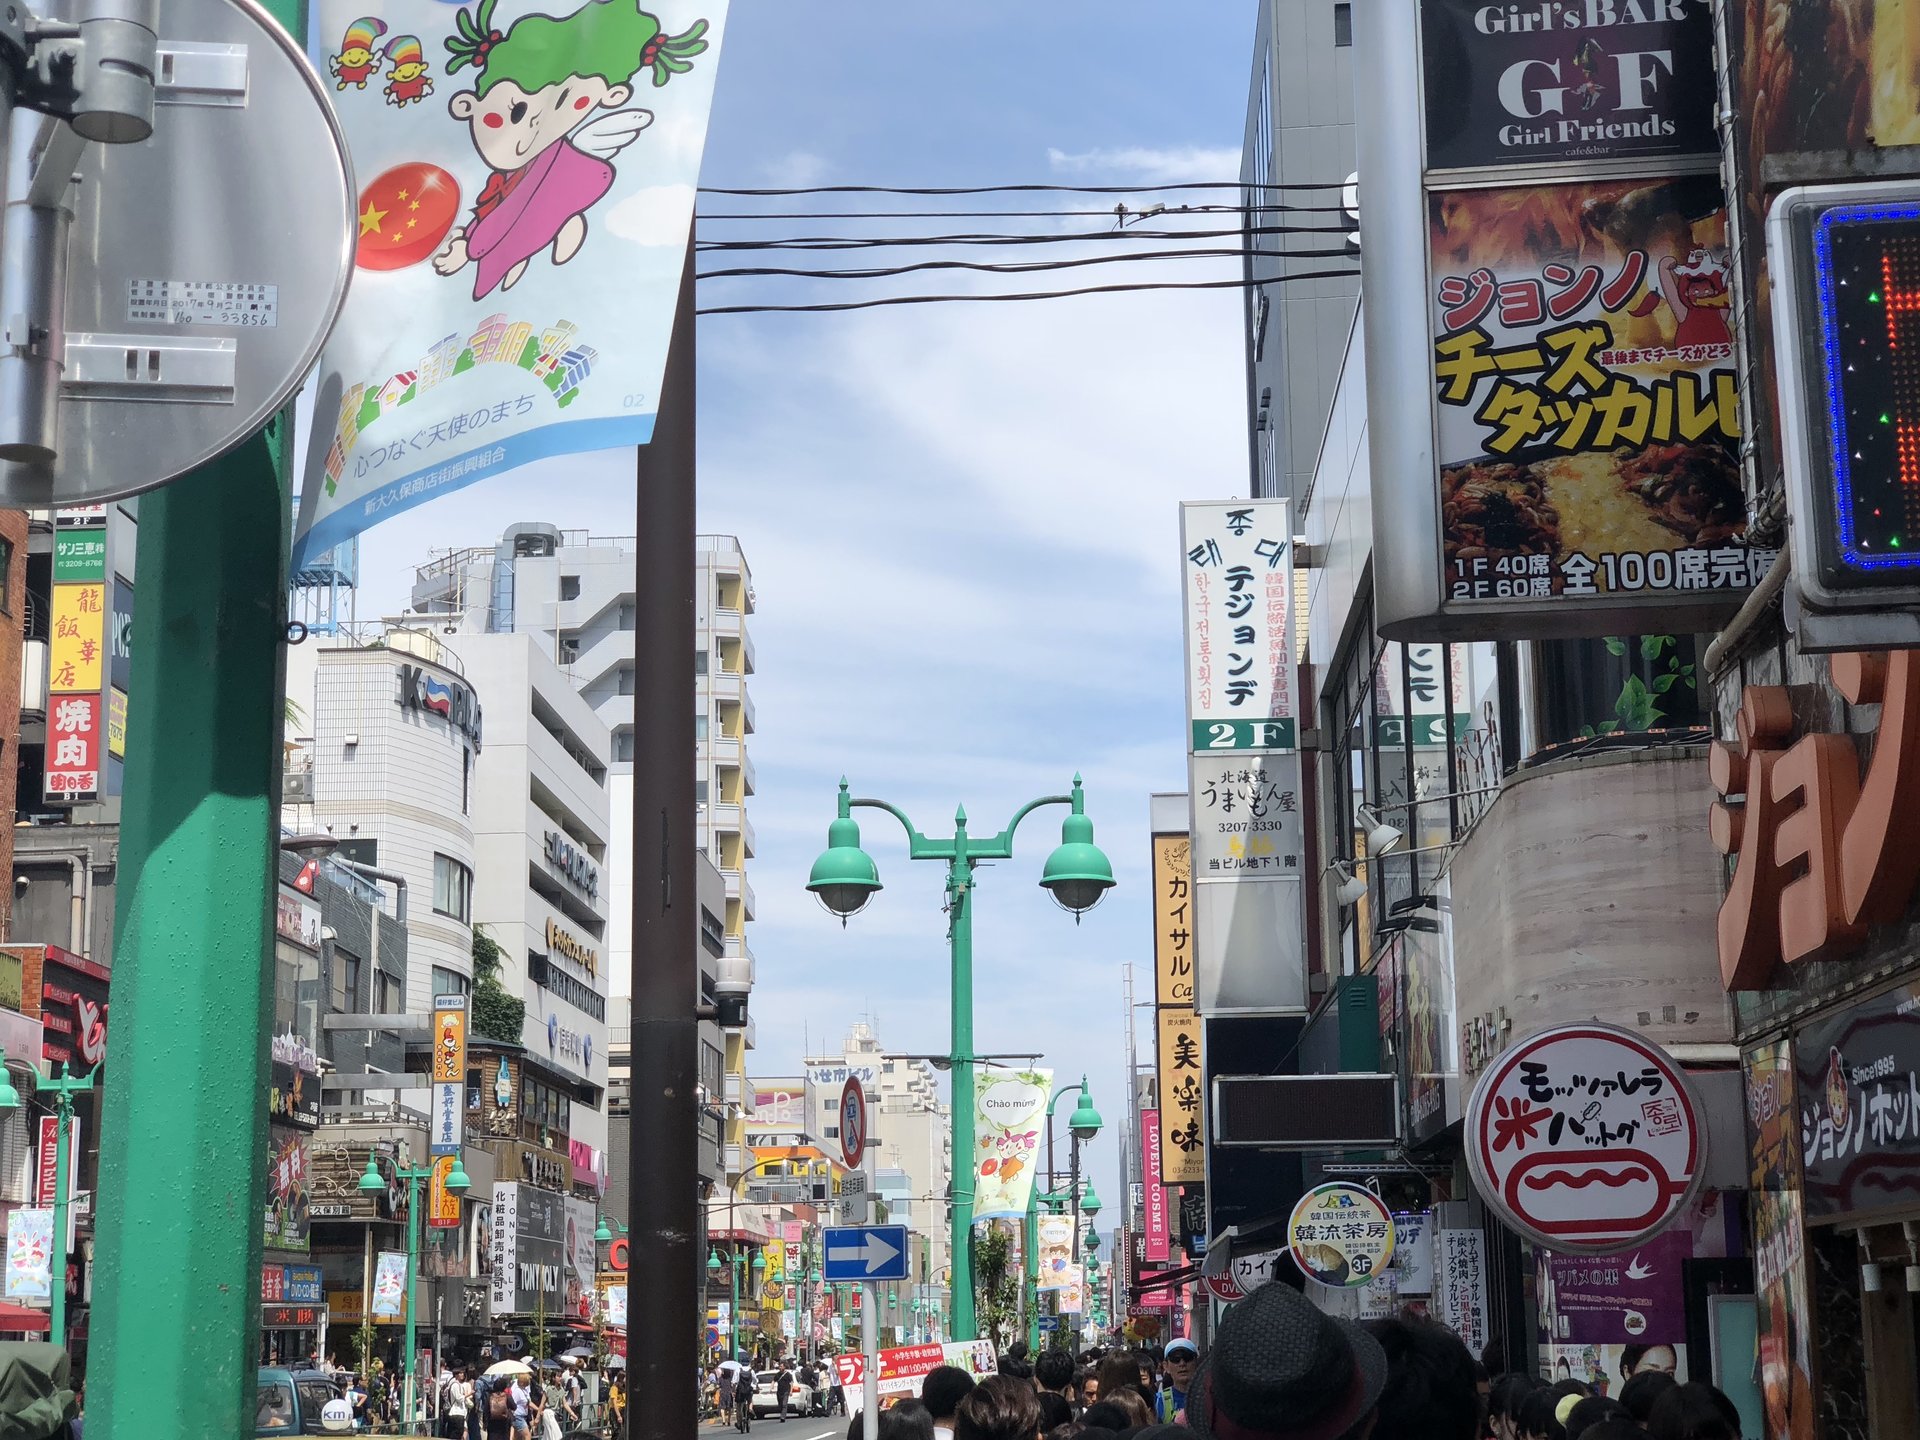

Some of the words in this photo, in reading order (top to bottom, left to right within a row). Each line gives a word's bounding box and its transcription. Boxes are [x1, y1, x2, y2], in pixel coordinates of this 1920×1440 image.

[1499, 125, 1551, 146] Girl
[1559, 114, 1676, 144] Friends
[1565, 146, 1611, 157] cafe&bar
[184, 282, 265, 292] 東京都公安委員会
[1440, 250, 1649, 330] ジョンノ
[130, 299, 168, 307] 設置年月日
[131, 311, 166, 319] 規制番号
[221, 312, 268, 325] 33856
[1435, 325, 1612, 402] チーズ
[623, 393, 645, 408] 02
[353, 394, 536, 479] 心つなぐ天使のまち
[363, 446, 507, 517] 新大久保商店街振興組合
[73, 517, 91, 525] 2F
[1495, 554, 1550, 575] 40席
[1496, 579, 1551, 598] 60席
[1224, 566, 1257, 707] テジョンデ
[54, 699, 91, 767] 焼肉
[1208, 722, 1287, 749] 2F
[51, 773, 94, 792] 明日香
[1221, 769, 1270, 784] 北海道
[1202, 780, 1296, 817] うまいもん屋
[1209, 855, 1297, 870] 当ビル地下1階
[1169, 876, 1191, 977] カイサル
[1520, 1061, 1663, 1103] モッツァレラ
[1852, 1055, 1895, 1086] Since1995
[1170, 1033, 1204, 1153] 美楽味
[440, 1083, 456, 1144] 盛好堂書店
[1149, 1125, 1160, 1178] LOVELY
[1151, 1183, 1162, 1233] COSME
[1310, 1210, 1371, 1221] 韓国伝統茶
[507, 1193, 518, 1298] TONYMOLY
[1294, 1221, 1389, 1242] 韓流茶房
[493, 1191, 506, 1303] 化粧品卸売相談可能
[520, 1262, 540, 1291] TONY
[1239, 1259, 1276, 1276] カイ
[1352, 1258, 1372, 1273] 3F
[1130, 1306, 1161, 1316] COSME
[324, 1411, 346, 1422] km
